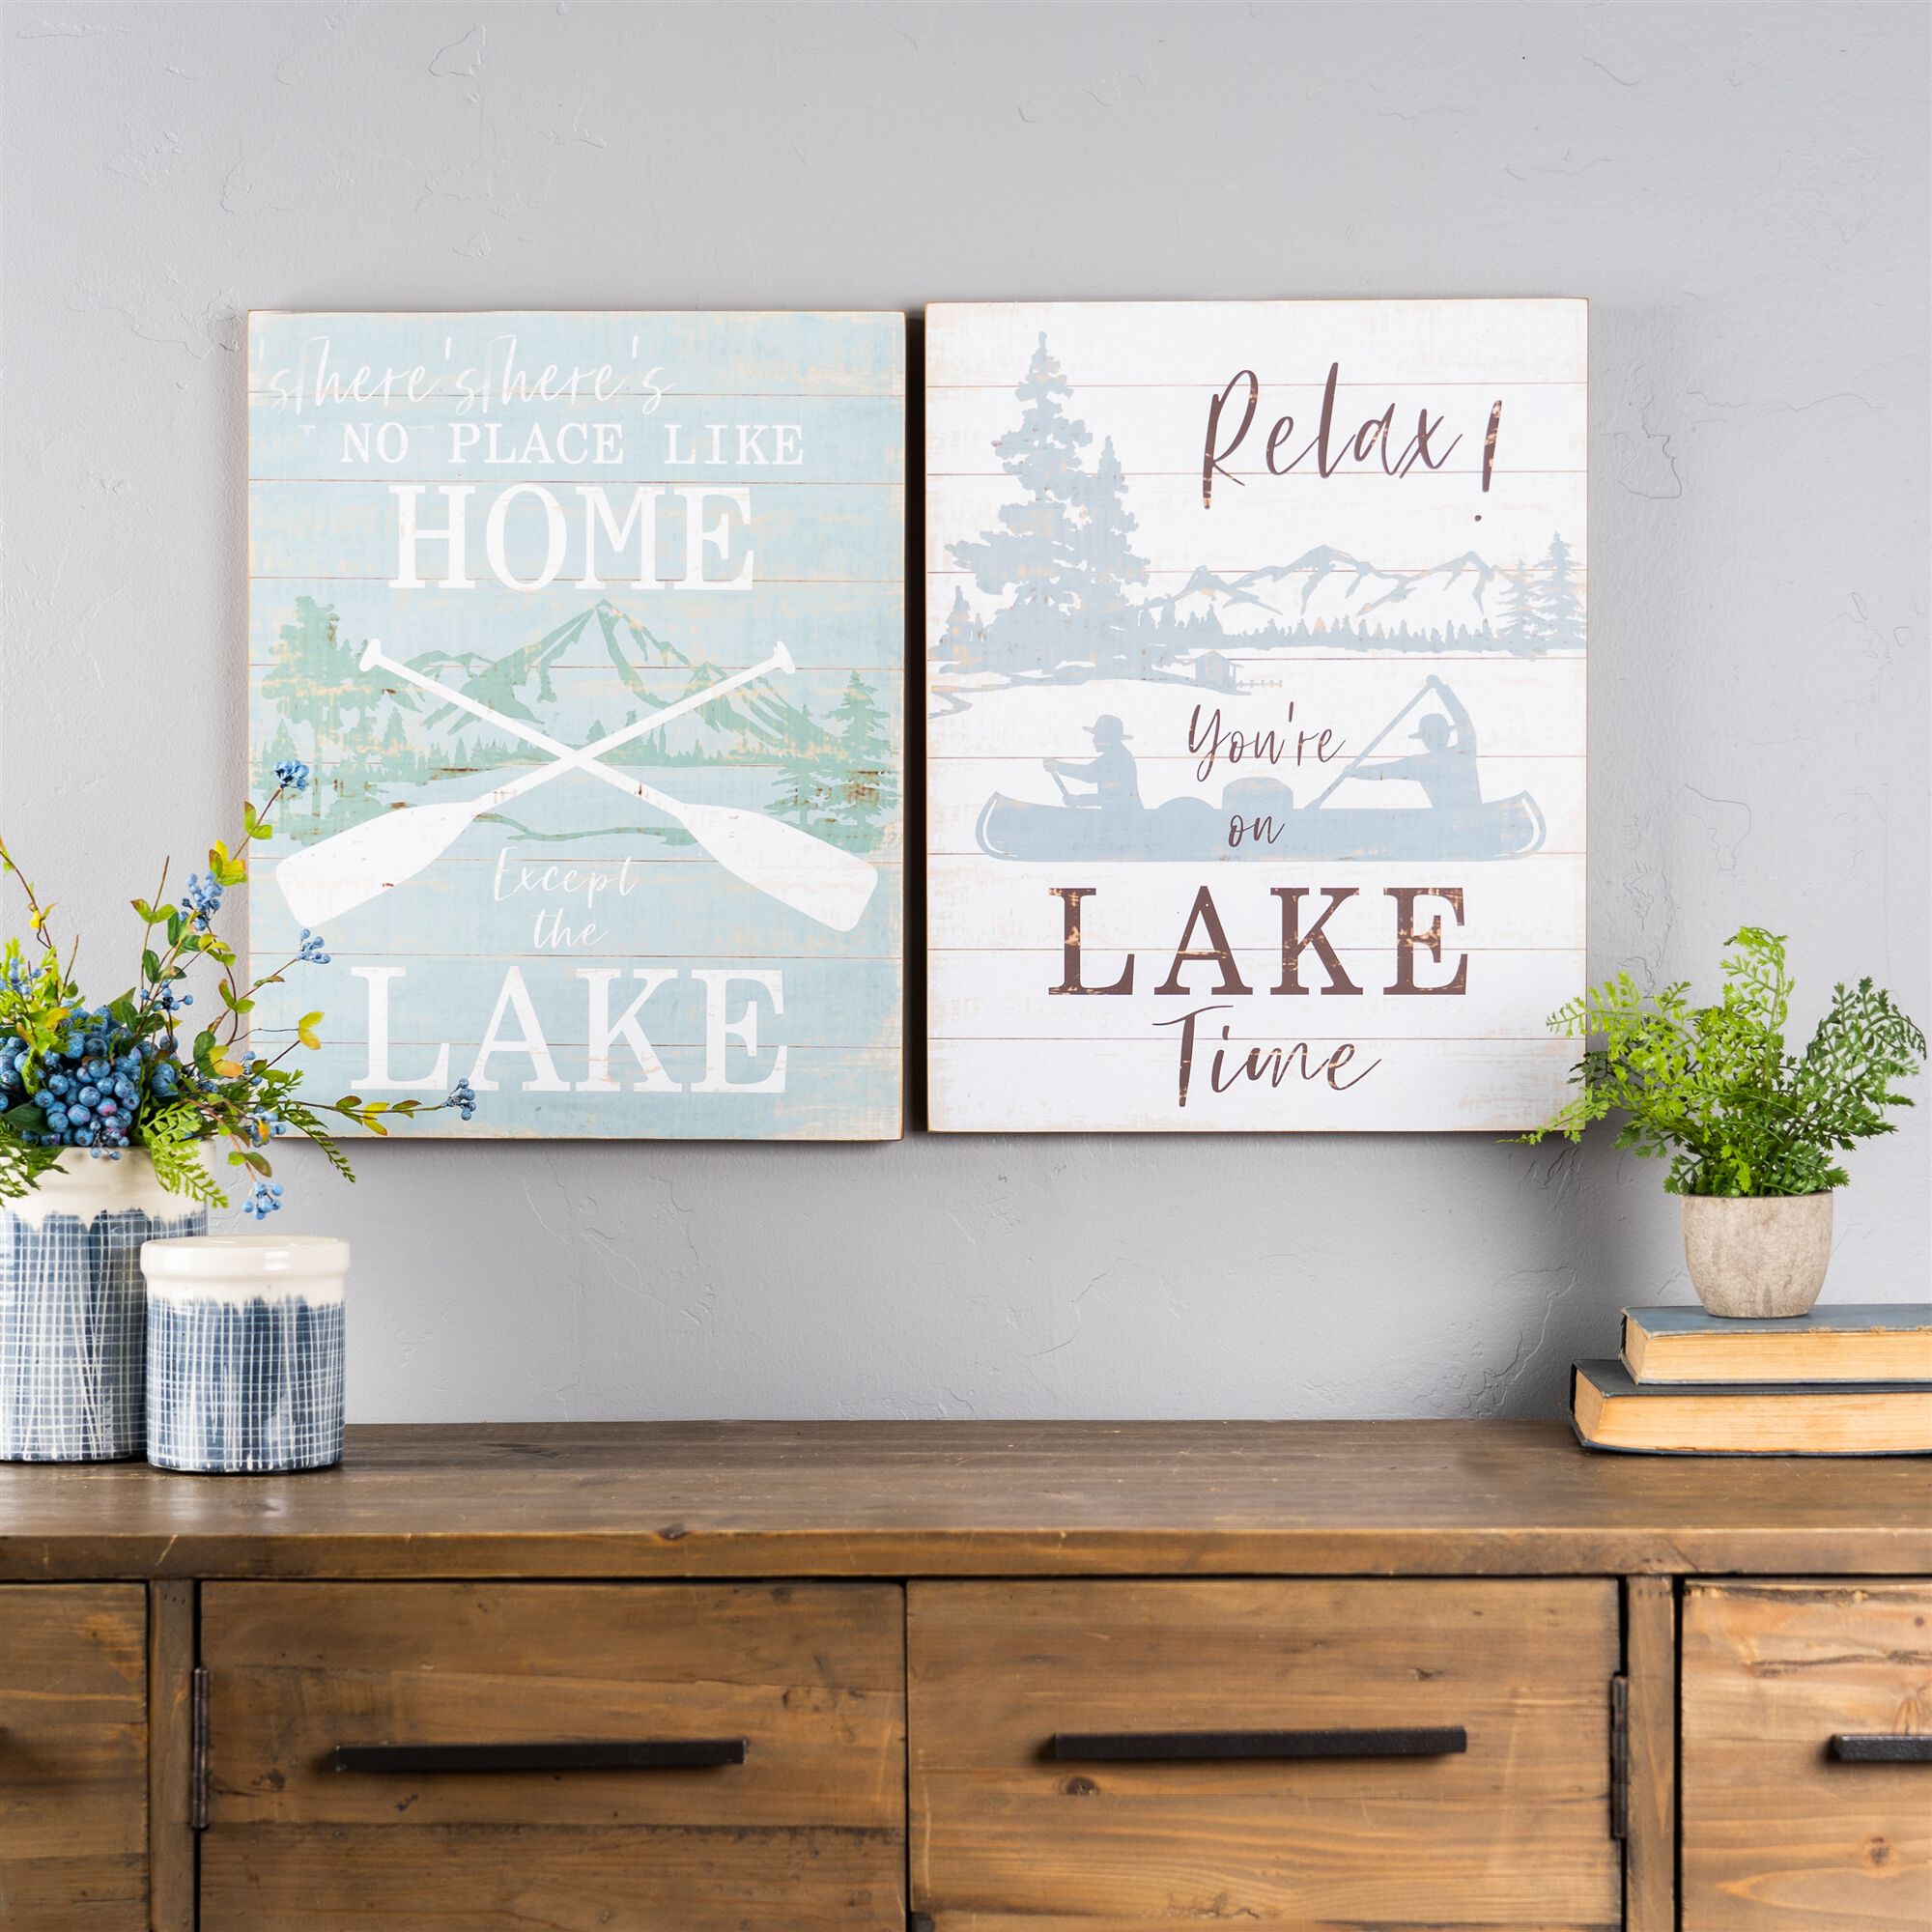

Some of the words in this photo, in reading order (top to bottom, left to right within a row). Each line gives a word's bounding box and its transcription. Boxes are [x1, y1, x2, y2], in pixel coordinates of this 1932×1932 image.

[340, 422, 410, 465] NO
[448, 422, 624, 466] PLACE
[664, 423, 805, 467] LIKE
[387, 483, 755, 591] HOME
[1188, 701, 1347, 782] You're
[1228, 814, 1286, 848] on
[494, 846, 639, 909] Except
[532, 908, 610, 949] the
[1048, 885, 1469, 996] LAKE
[350, 965, 788, 1094] LAKE
[1151, 1005, 1382, 1108] Time
